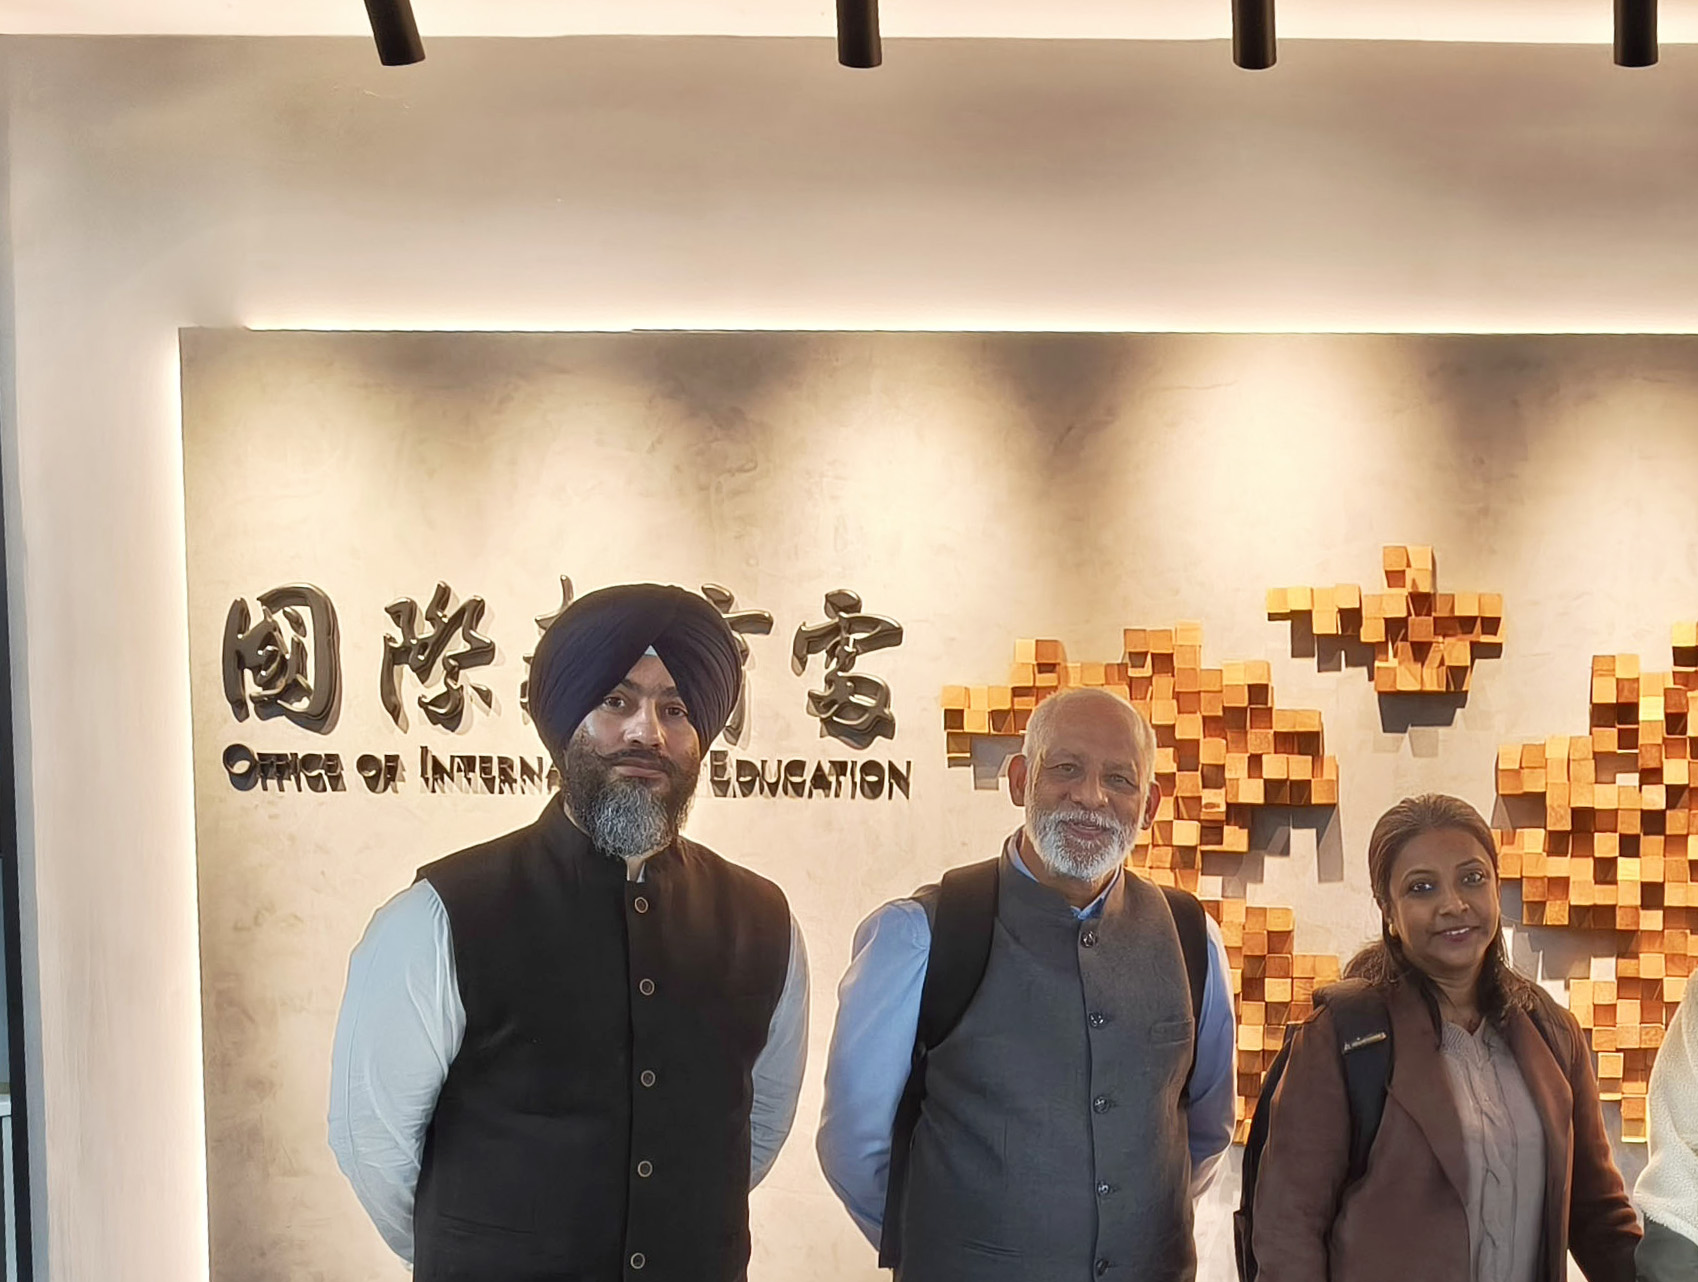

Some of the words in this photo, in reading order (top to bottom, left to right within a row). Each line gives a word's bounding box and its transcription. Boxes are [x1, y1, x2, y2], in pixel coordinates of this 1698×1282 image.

[222, 574, 904, 751] 國際處
[222, 743, 347, 792] OFFICE
[356, 754, 404, 793] OF
[710, 750, 912, 799] EDUCATION
